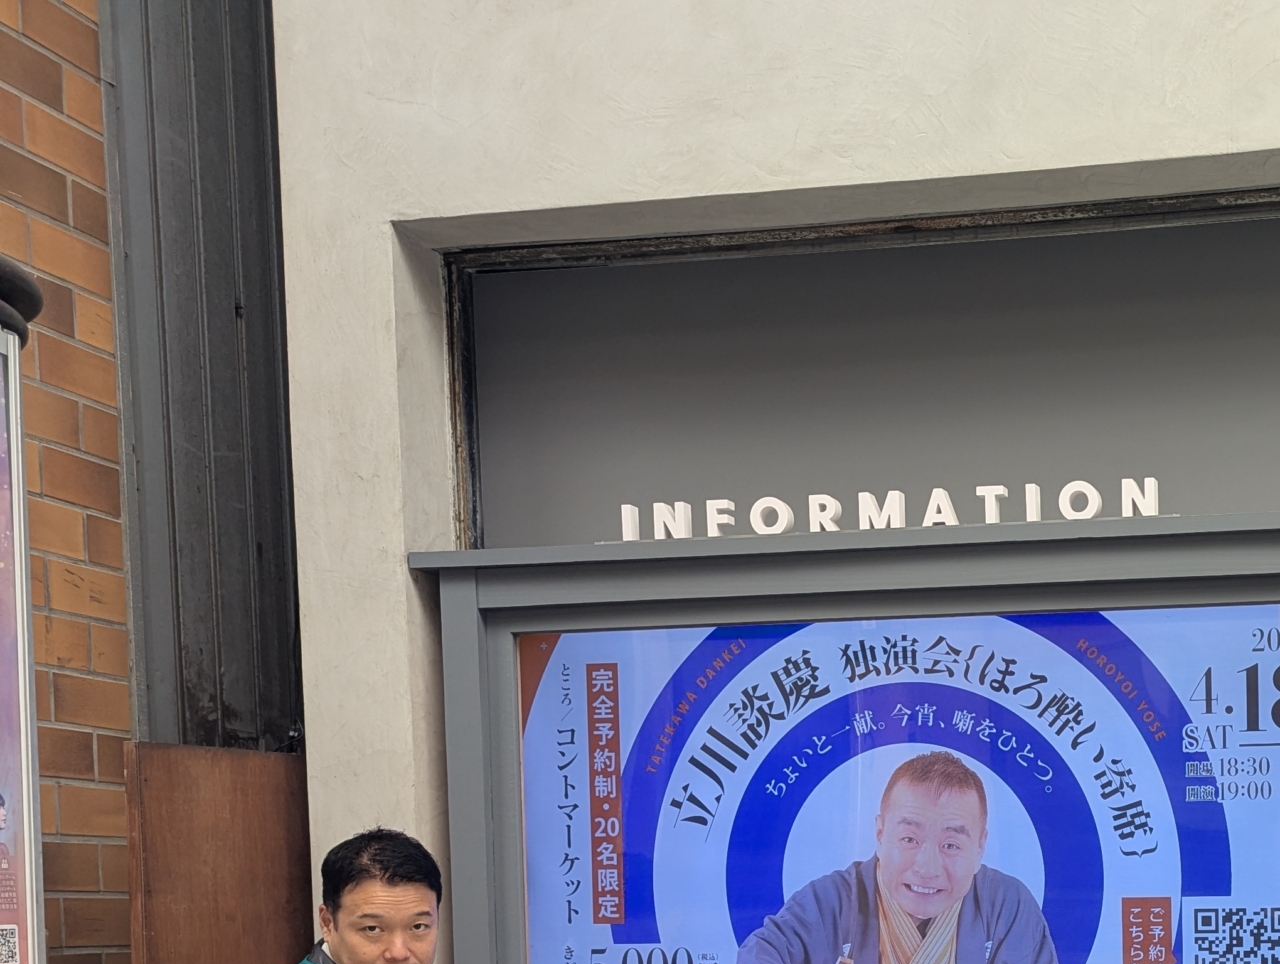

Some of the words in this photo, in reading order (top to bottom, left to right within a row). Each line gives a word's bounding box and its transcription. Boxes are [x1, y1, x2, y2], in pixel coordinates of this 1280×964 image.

[620, 476, 1159, 542] INFORMATION
[645, 690, 698, 775] TATEKAWA
[695, 637, 748, 690] DANKEI
[1076, 638, 1139, 700] HOROYOI
[1136, 699, 1168, 743] YOSE
[669, 649, 832, 844] 立川談慶
[1184, 724, 1234, 751] SAT
[1218, 756, 1271, 777] 18:30
[591, 668, 621, 919] 完全予約制・20名限定
[1218, 780, 1273, 801] 19:00
